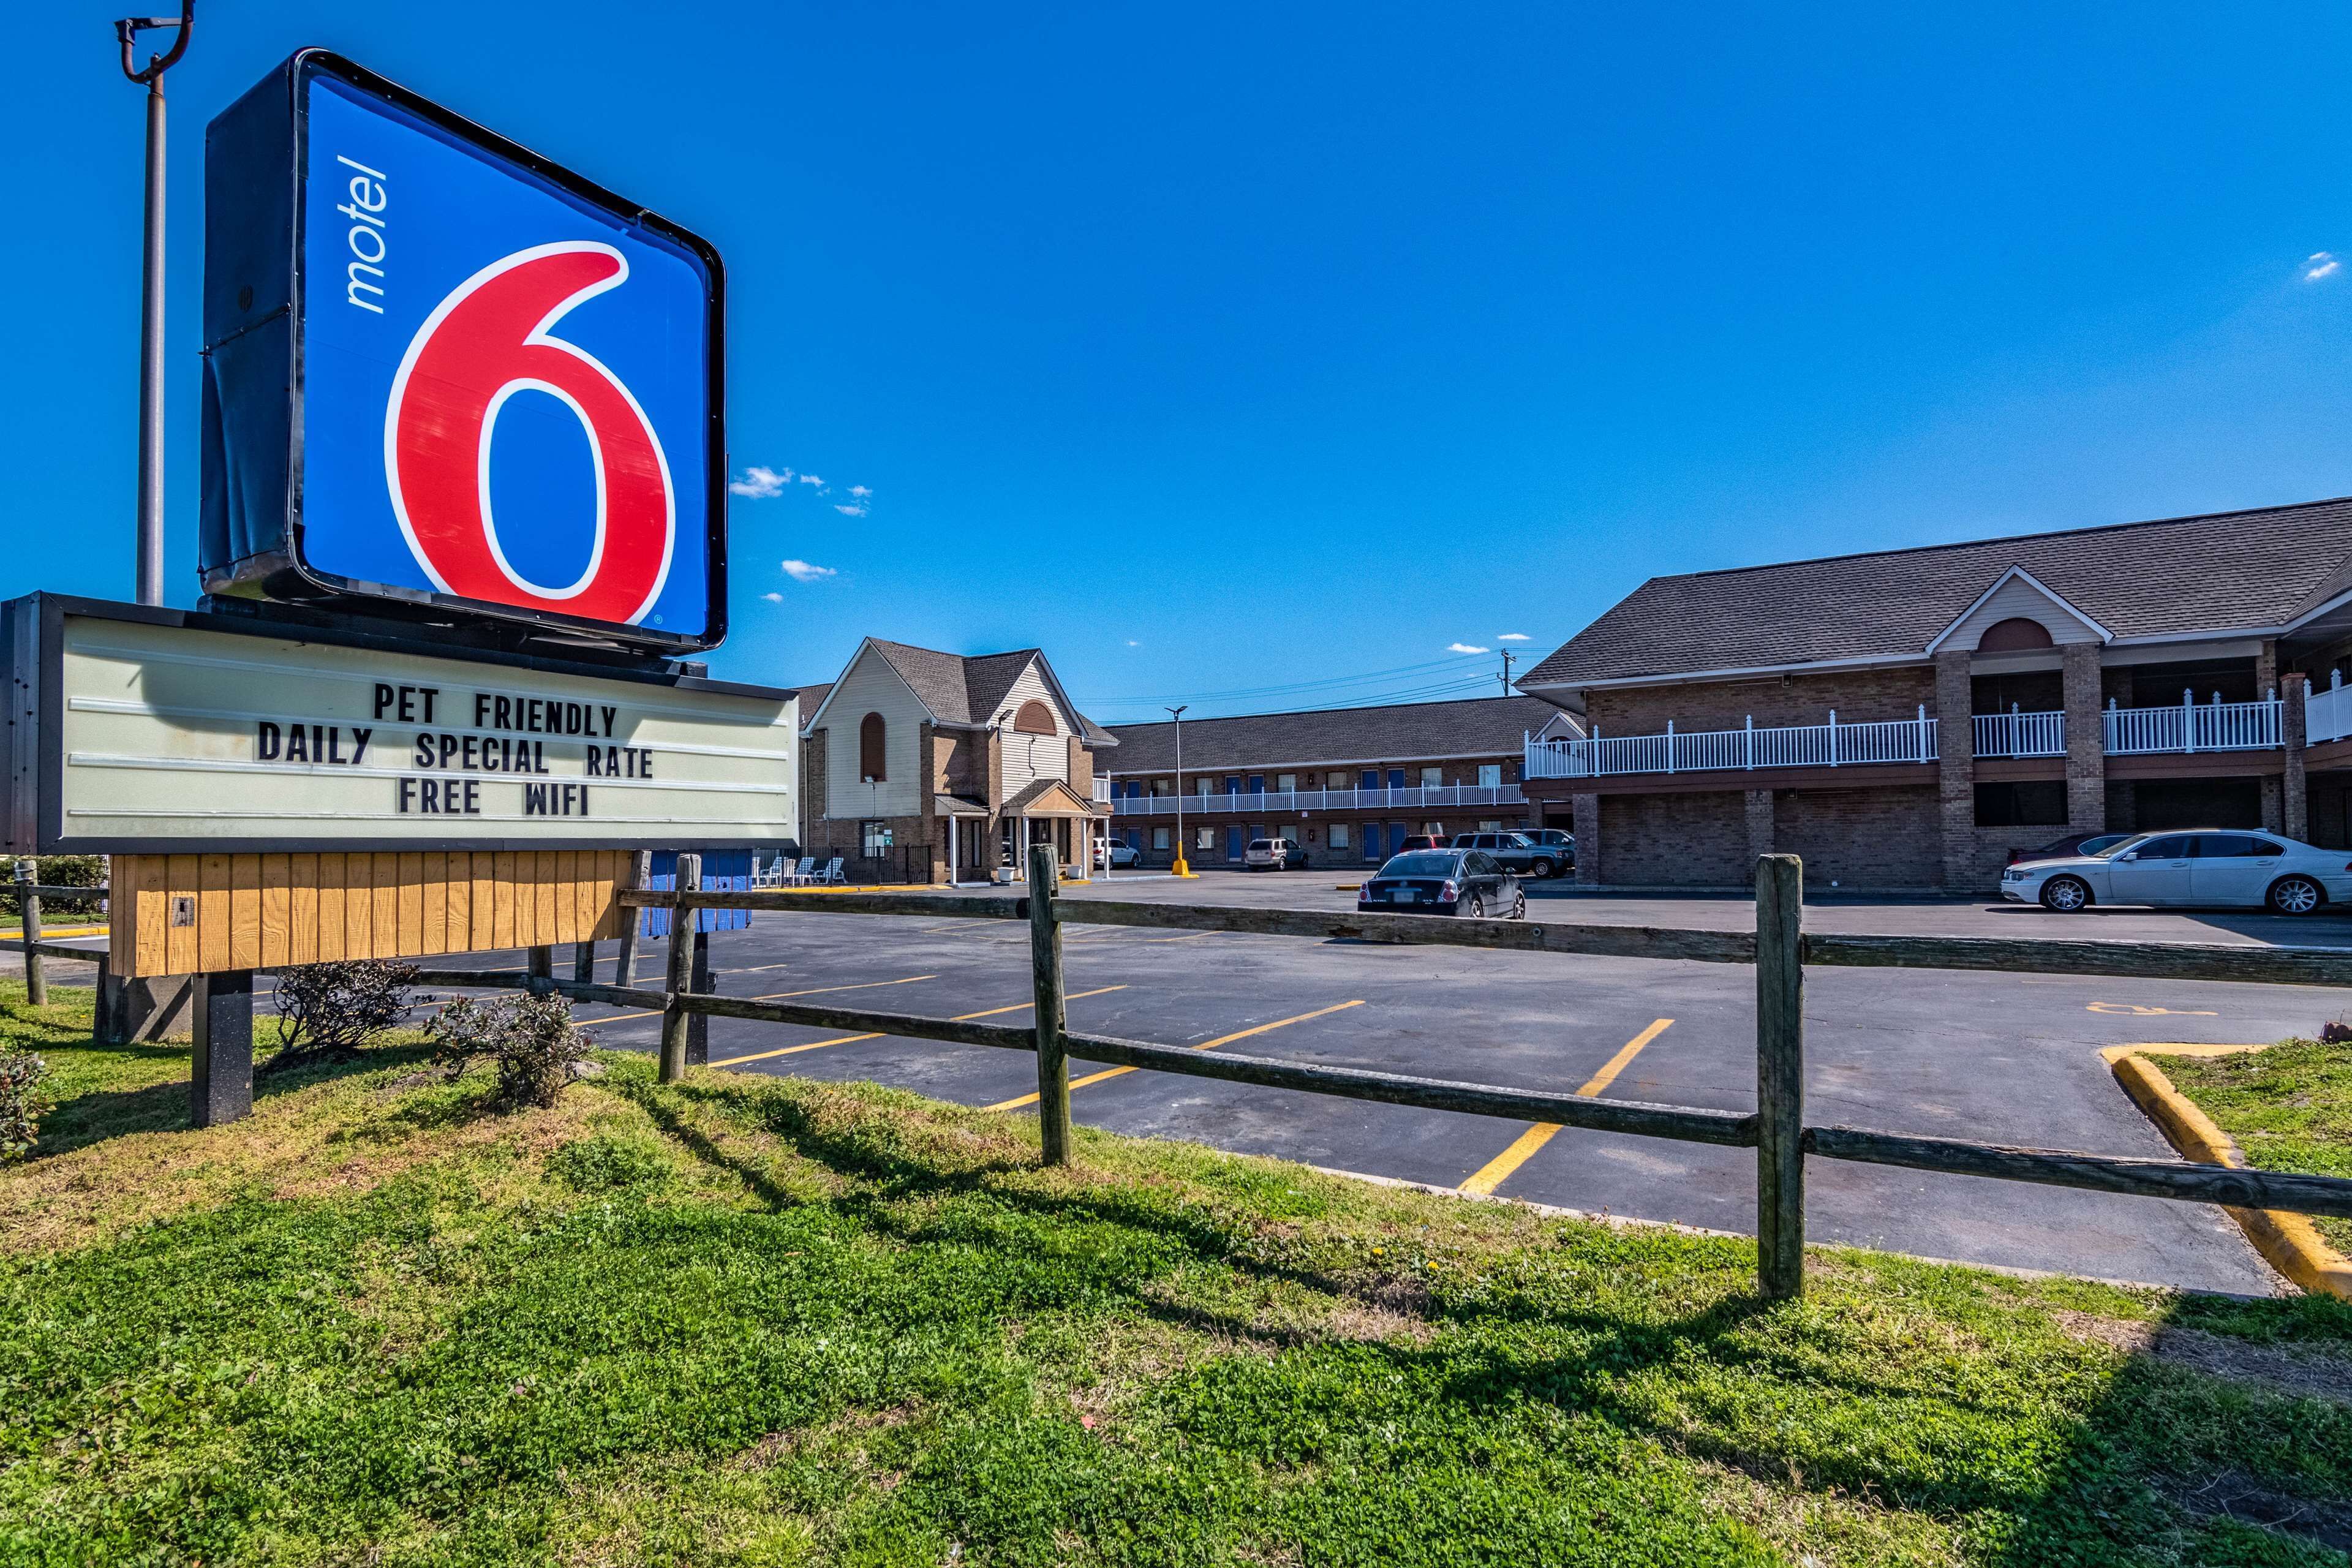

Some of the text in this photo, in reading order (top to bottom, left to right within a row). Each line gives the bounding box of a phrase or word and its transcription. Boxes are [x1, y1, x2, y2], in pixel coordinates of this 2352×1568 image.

[337, 154, 387, 314] motel
[384, 240, 676, 625] 6
[374, 683, 617, 737] PET FRIENDLY
[258, 721, 653, 778] DAILY SPECIAL RATE
[400, 778, 589, 816] FREE WIFI
